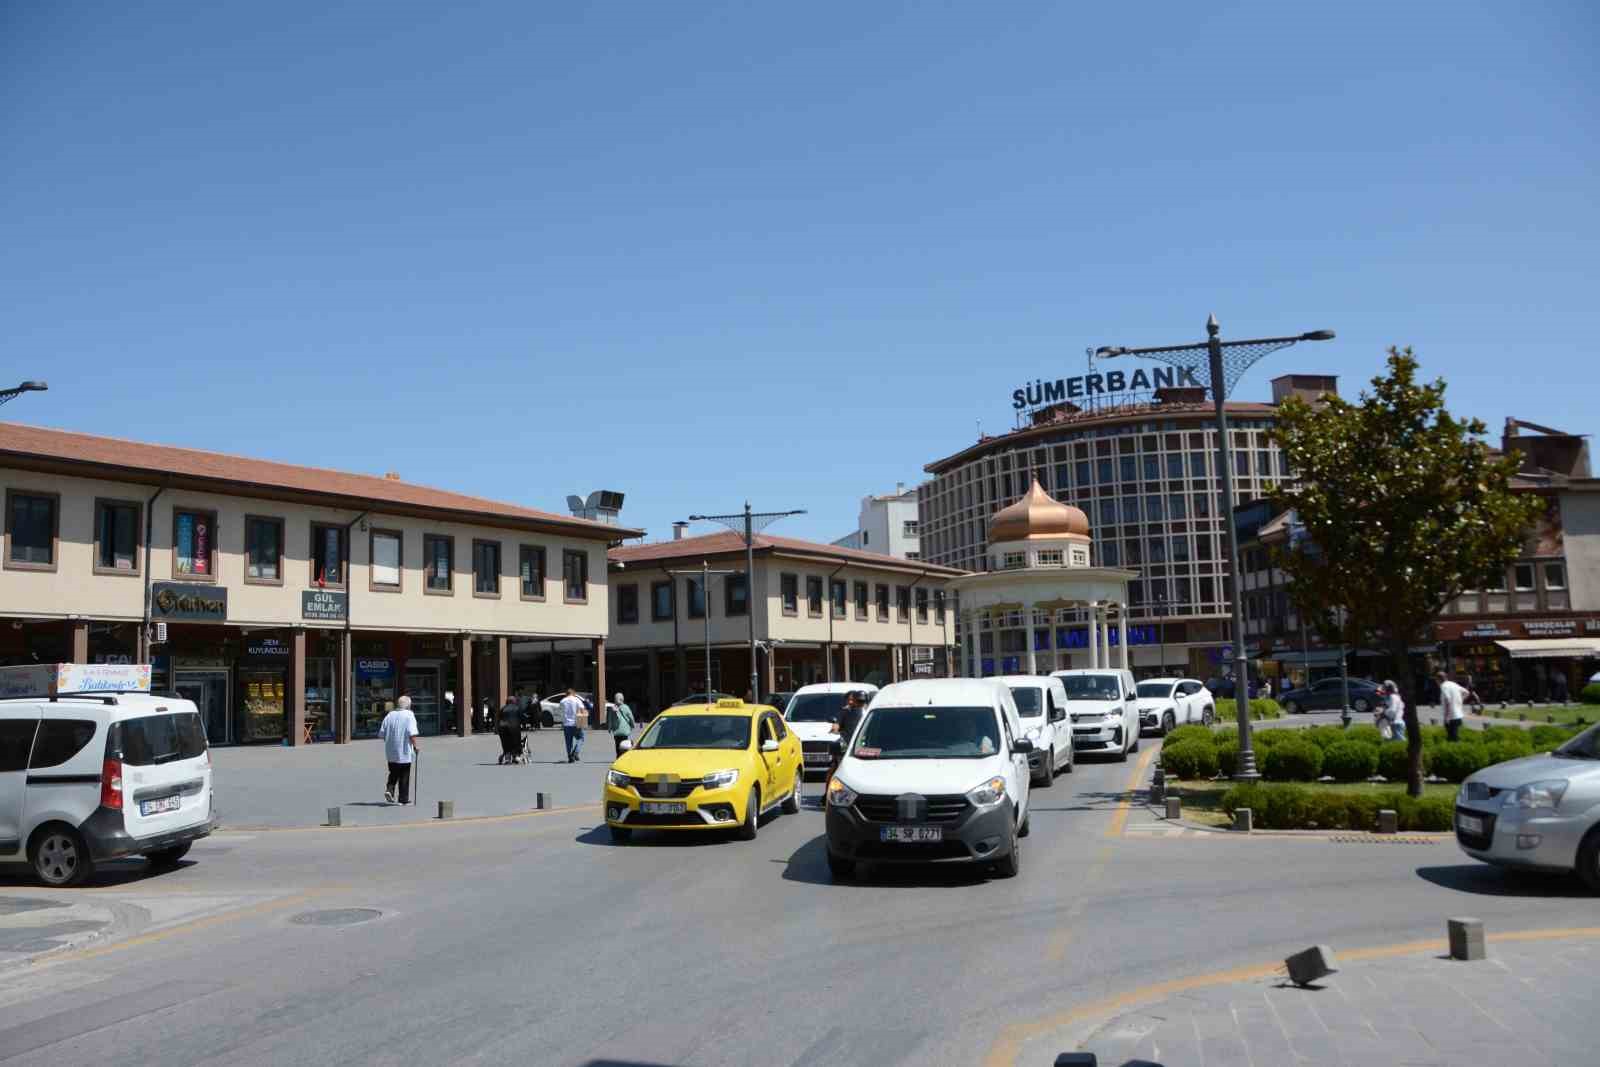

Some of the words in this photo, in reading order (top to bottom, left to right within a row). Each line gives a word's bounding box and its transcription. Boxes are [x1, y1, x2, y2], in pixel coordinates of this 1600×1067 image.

[1012, 365, 1198, 409] SÜMERBANK
[314, 592, 335, 603] GÜL
[306, 601, 342, 612] EMLAK
[359, 660, 390, 669] CASIO
